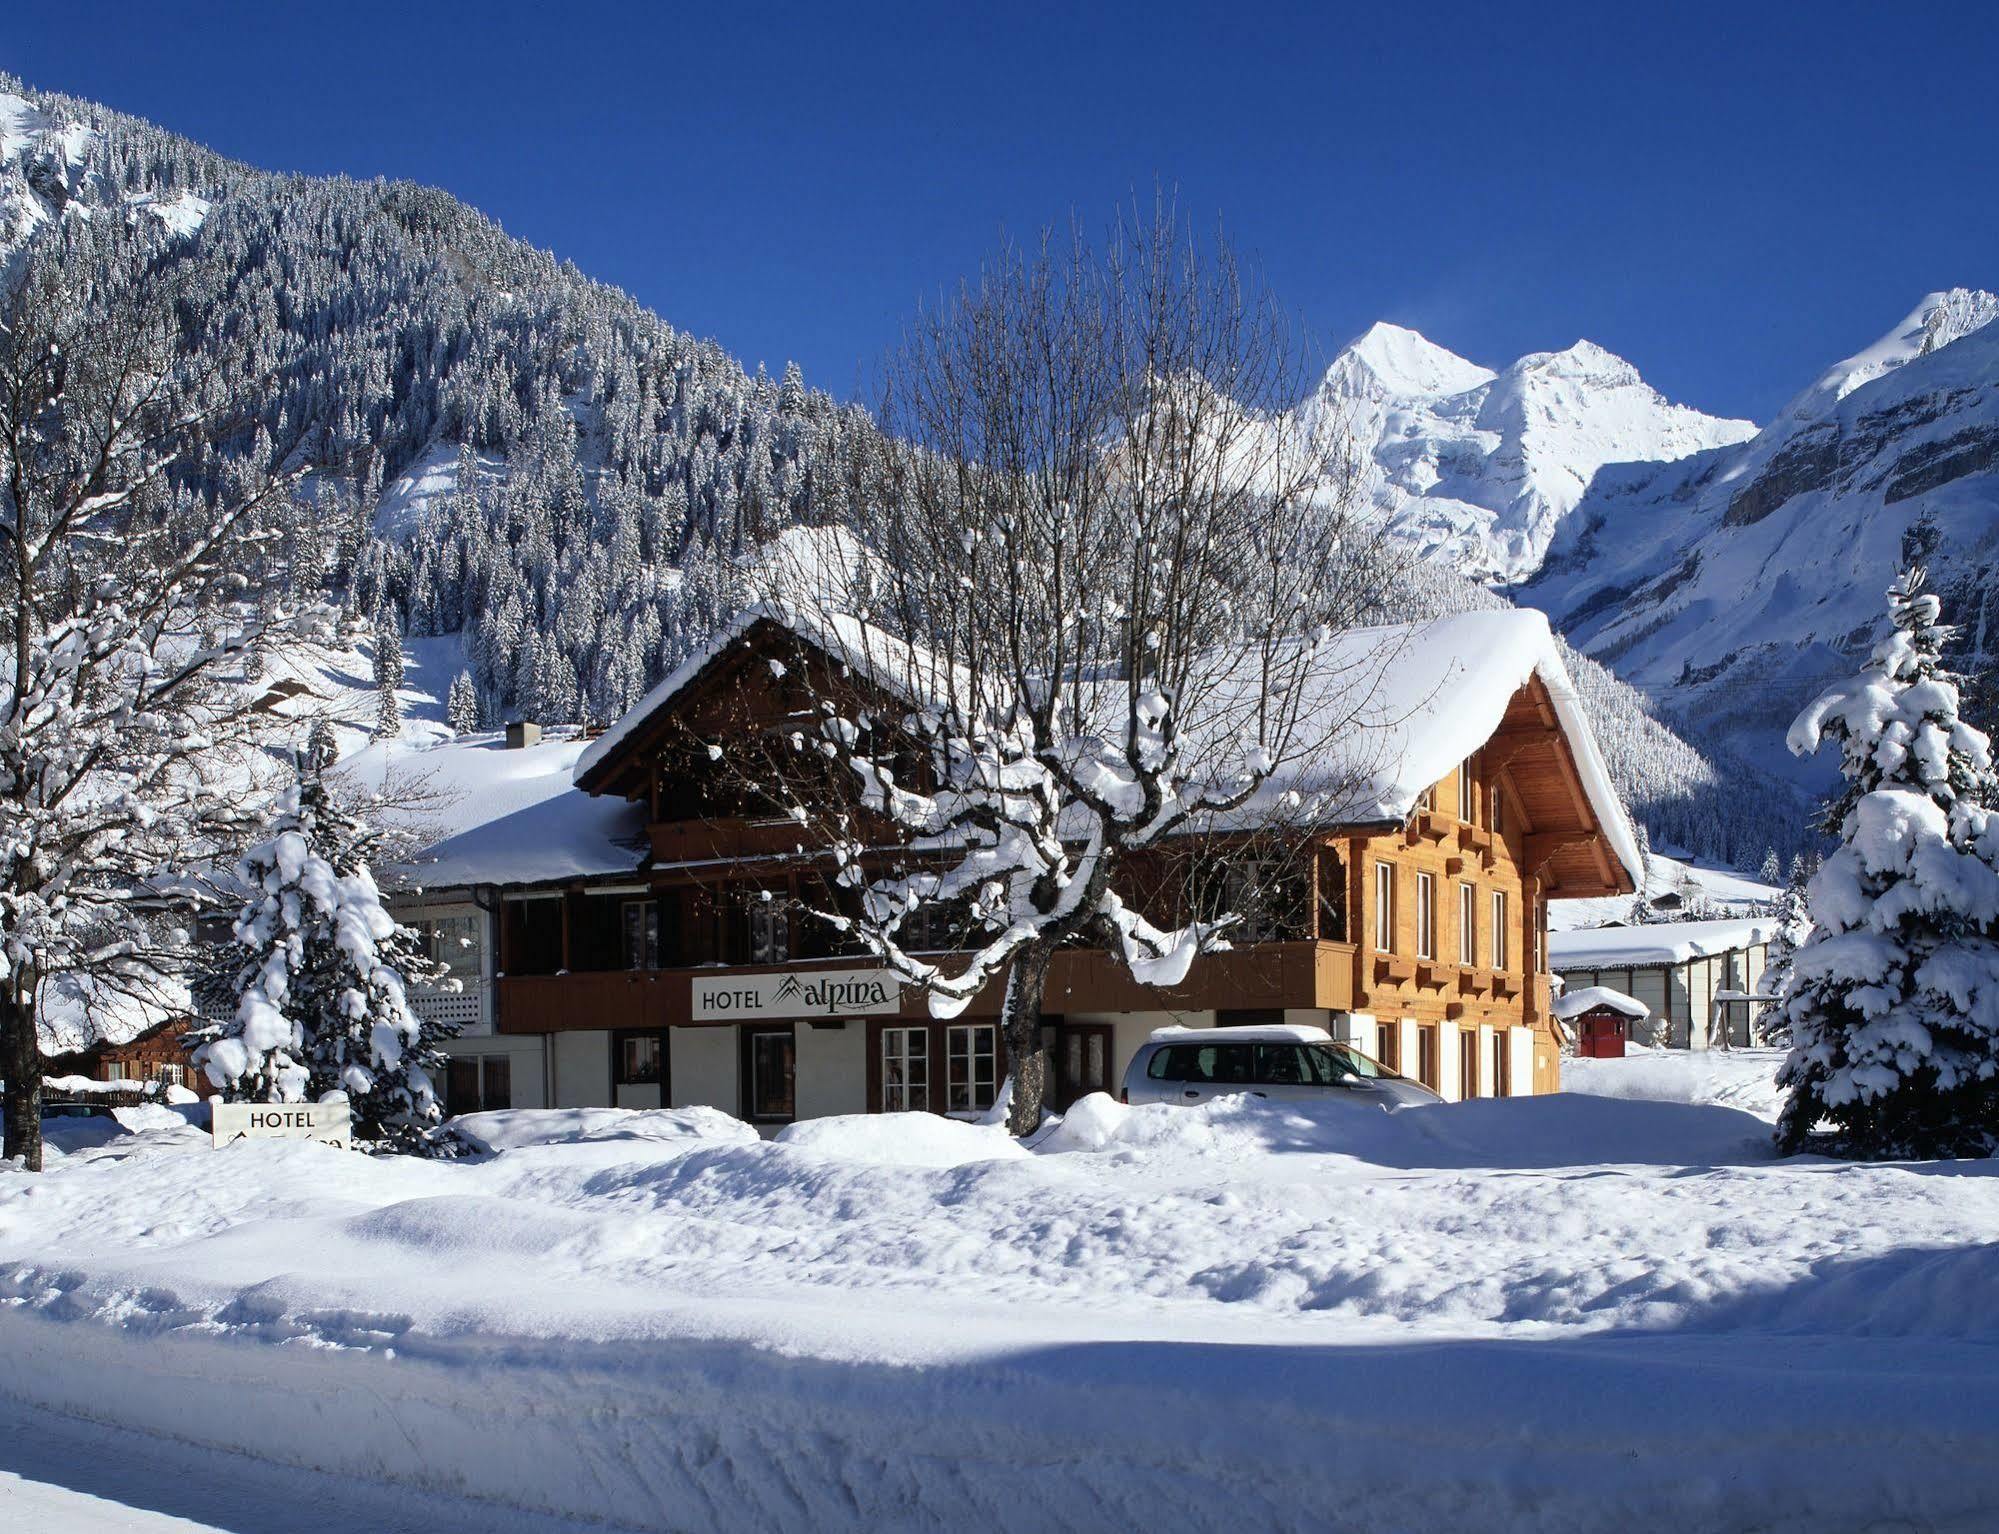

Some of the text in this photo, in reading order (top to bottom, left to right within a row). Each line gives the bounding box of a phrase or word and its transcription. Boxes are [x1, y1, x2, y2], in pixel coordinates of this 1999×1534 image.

[703, 976, 889, 1013] HOTEL alpina
[251, 1112, 315, 1128] HOTEL
